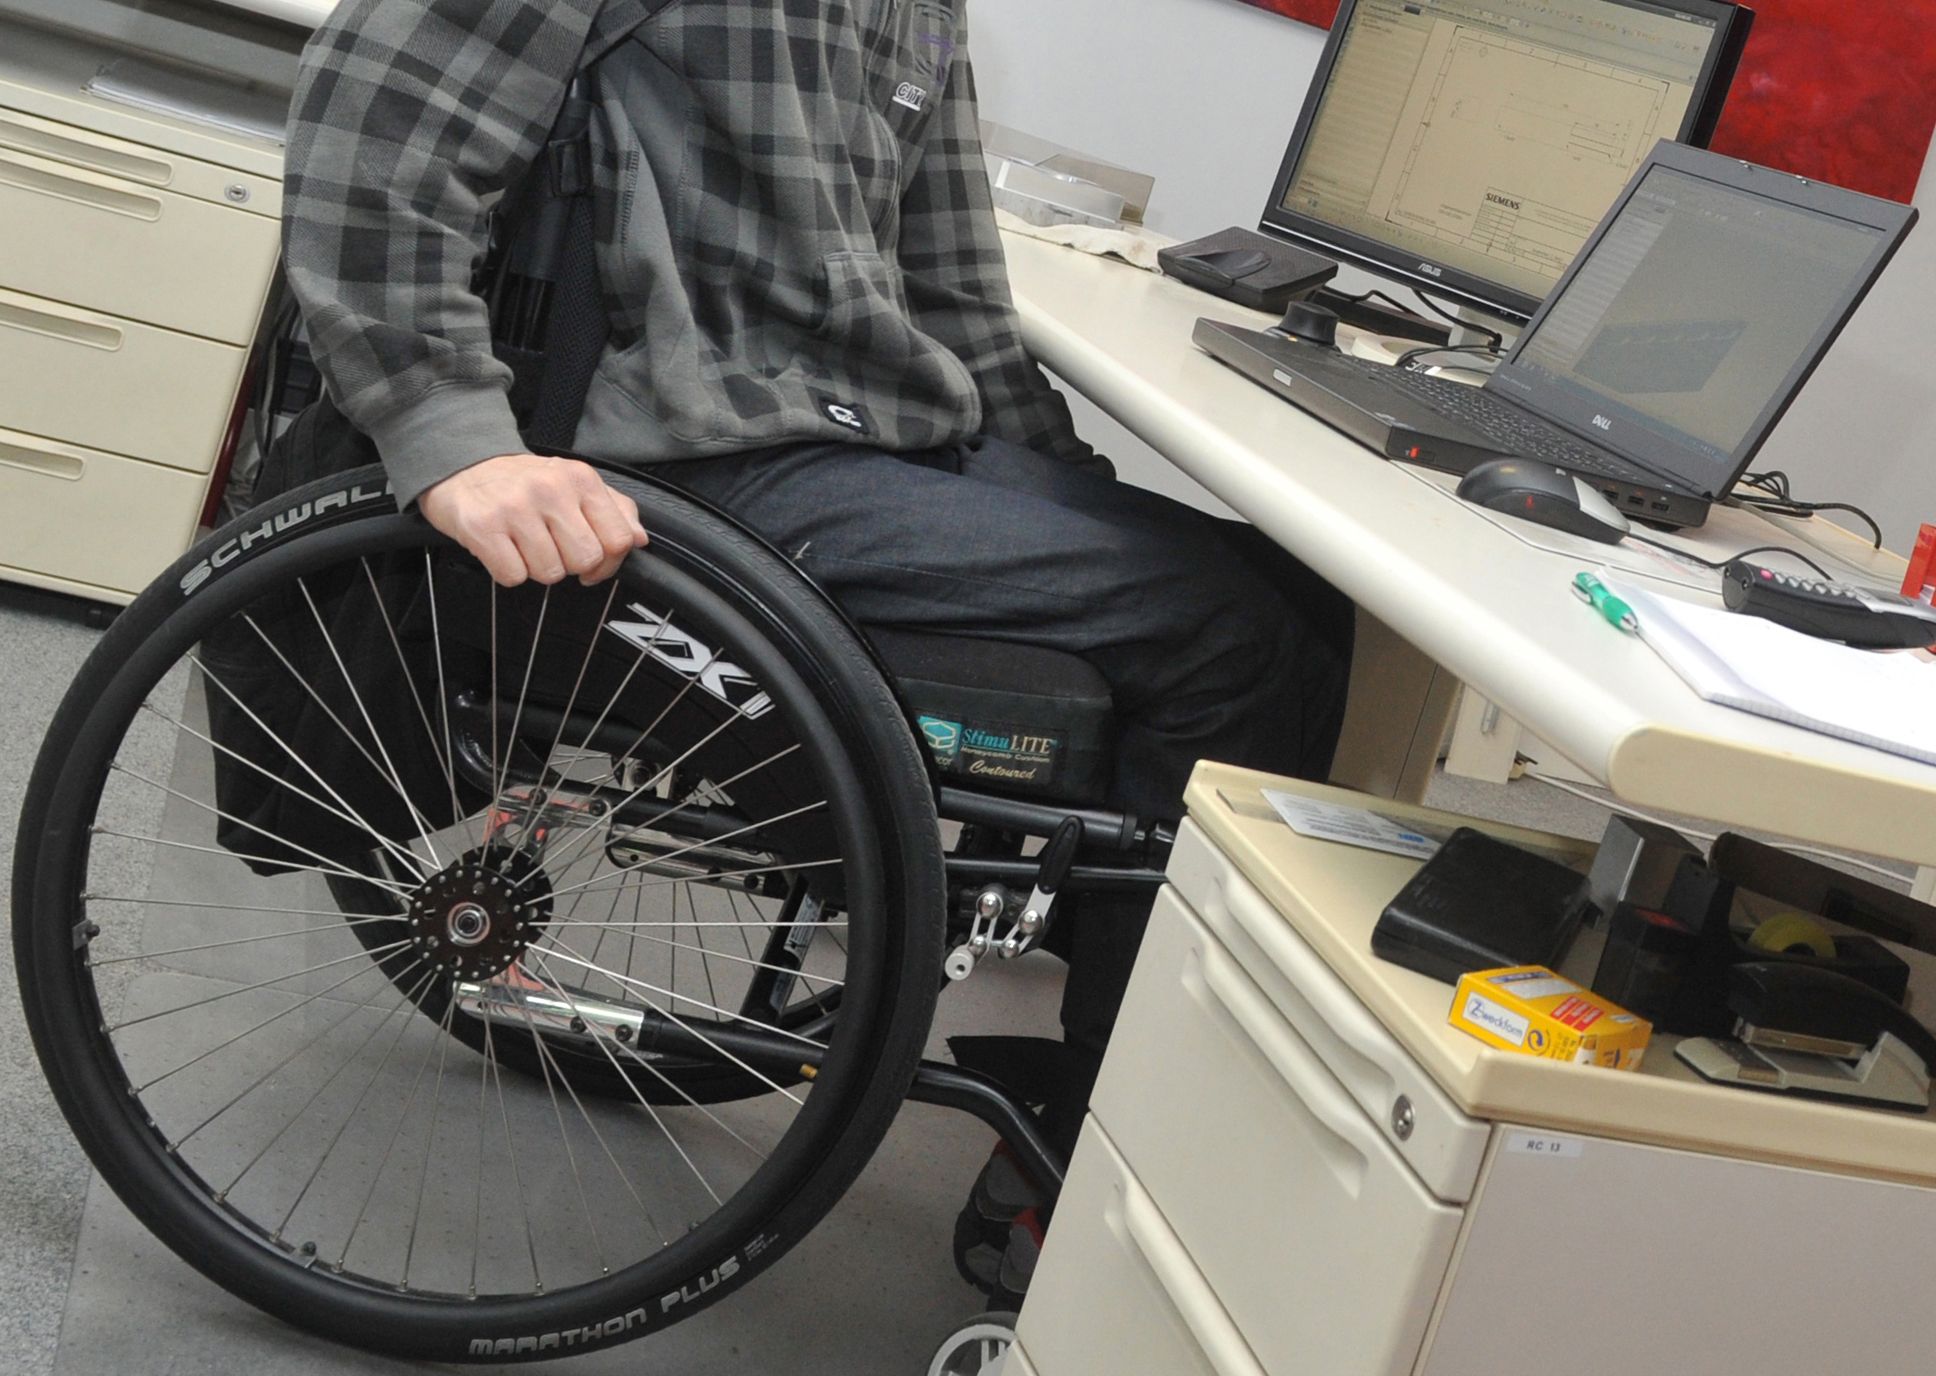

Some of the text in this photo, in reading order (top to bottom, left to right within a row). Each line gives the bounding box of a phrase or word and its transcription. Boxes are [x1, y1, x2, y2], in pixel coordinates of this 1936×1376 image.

[1486, 192, 1521, 211] SIEMENS
[1418, 263, 1442, 277] ASUS
[1592, 414, 1612, 430] DELL
[969, 759, 1037, 780] Contoured
[468, 1255, 740, 1356] MARATHON PLUS
